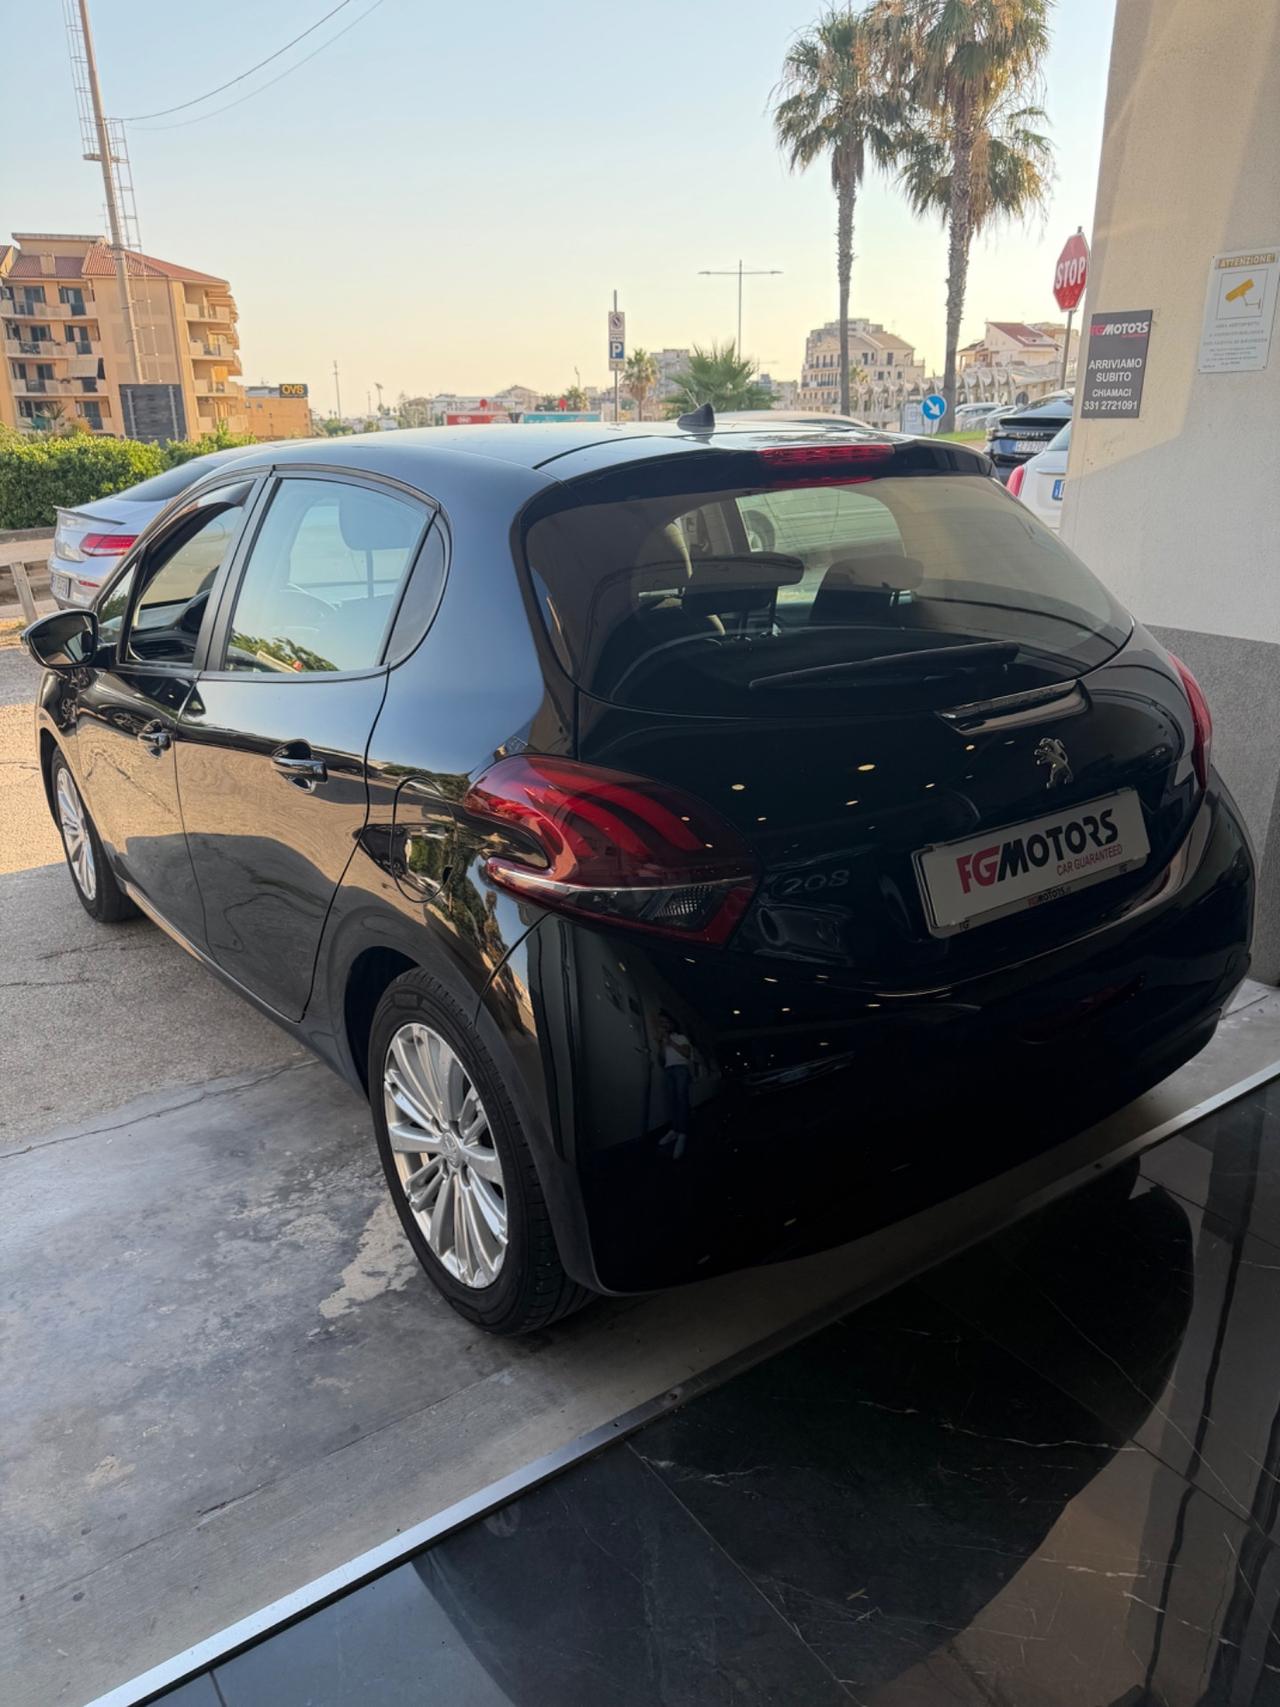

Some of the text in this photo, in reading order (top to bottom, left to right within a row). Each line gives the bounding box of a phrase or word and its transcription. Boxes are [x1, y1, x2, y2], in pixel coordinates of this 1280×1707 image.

[1219, 254, 1272, 267] ATTENZIONE
[1056, 256, 1085, 289] STOP
[612, 343, 622, 357] P
[1088, 357, 1142, 370] ARRIVIAMO
[1095, 371, 1132, 383] SUBITO
[282, 384, 304, 395] OVS
[1092, 388, 1132, 397] CHIAMACI
[1083, 400, 1137, 411] 331 2721091
[1056, 860, 1074, 876] CAR
[1074, 844, 1122, 872] GUARANTEED
[781, 869, 851, 896] 208
